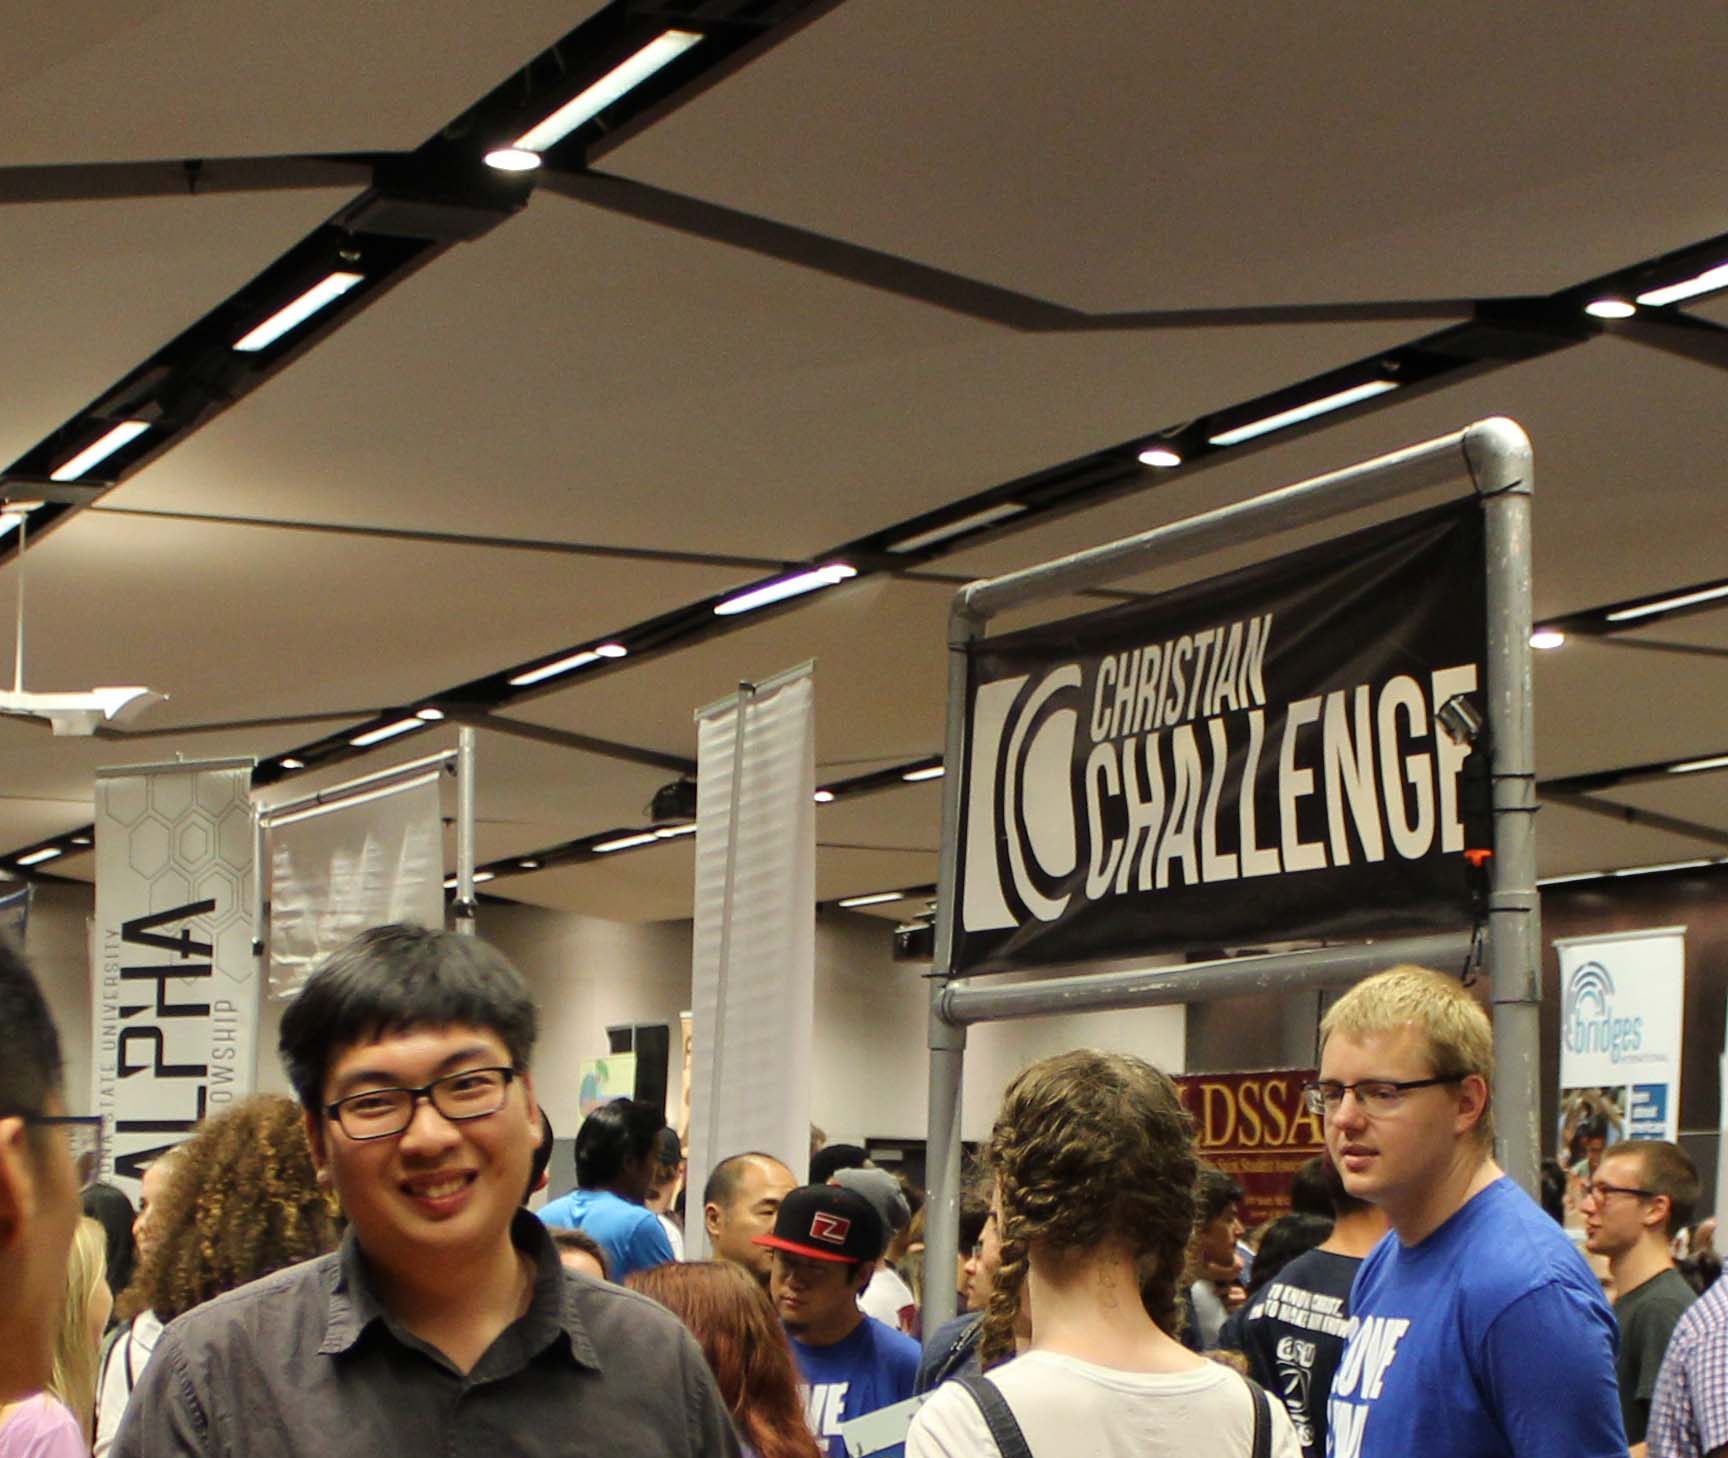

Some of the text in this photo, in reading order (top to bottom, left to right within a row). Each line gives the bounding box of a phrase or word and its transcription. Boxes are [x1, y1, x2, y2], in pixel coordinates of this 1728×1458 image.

[1091, 613, 1273, 743] CHRISTIAN
[1085, 663, 1477, 900] CHALLENGE
[101, 927, 121, 1052] UNIVERSITY
[114, 898, 216, 1182] ALPHA
[1575, 1006, 1642, 1064] bridges
[99, 1063, 118, 1121] STATE
[210, 999, 240, 1104] OWSHIP
[799, 1381, 849, 1437] VE
